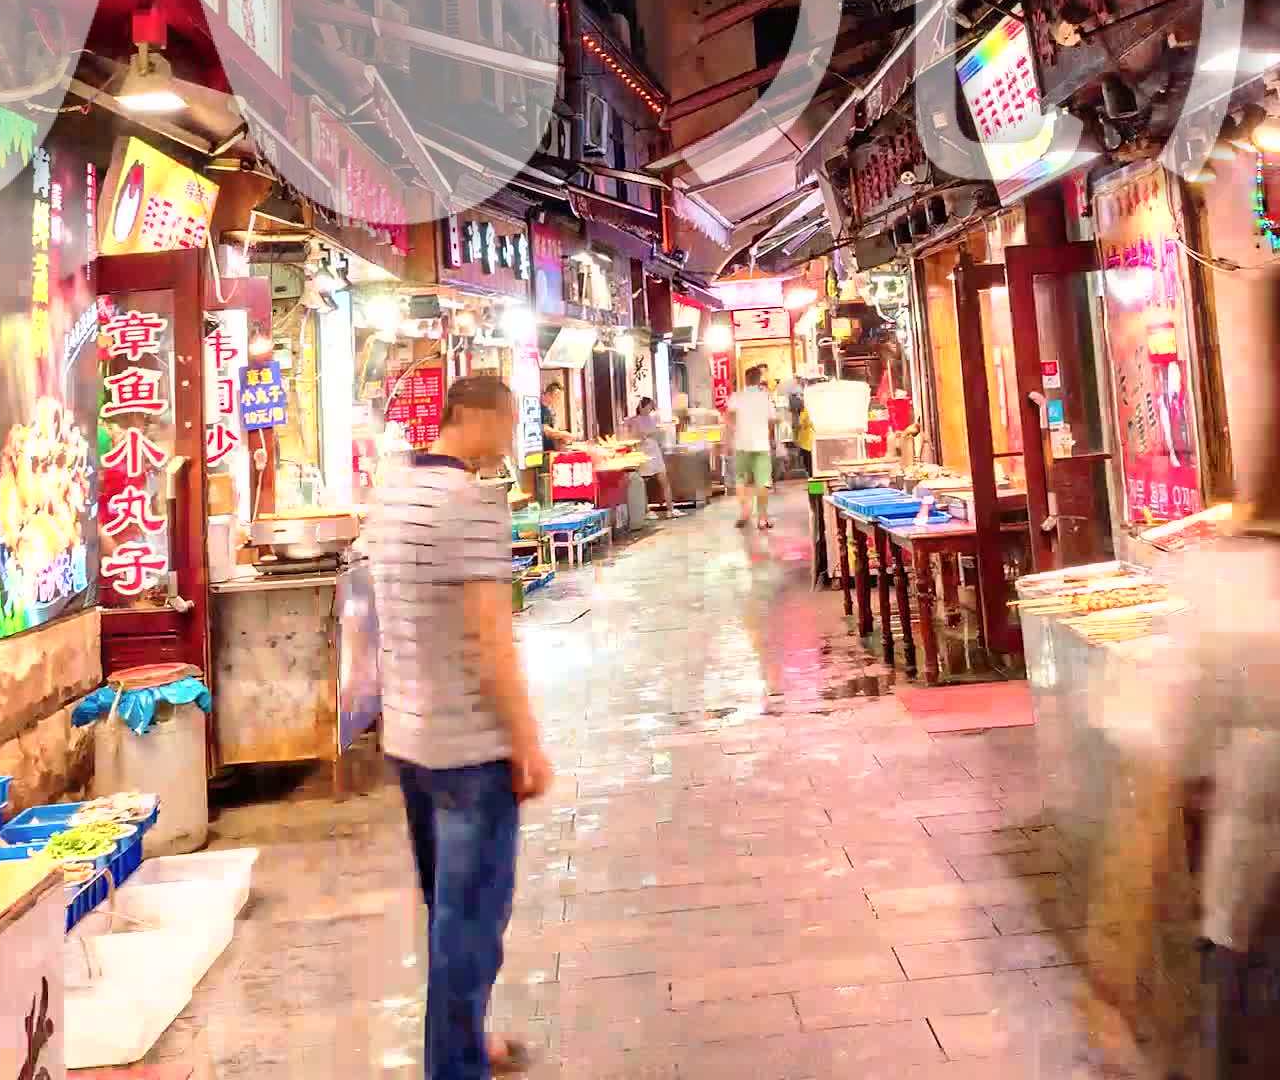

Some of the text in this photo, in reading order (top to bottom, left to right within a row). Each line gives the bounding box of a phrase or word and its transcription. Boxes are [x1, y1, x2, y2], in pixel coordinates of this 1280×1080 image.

[100, 310, 169, 597] 章鱼小丸子
